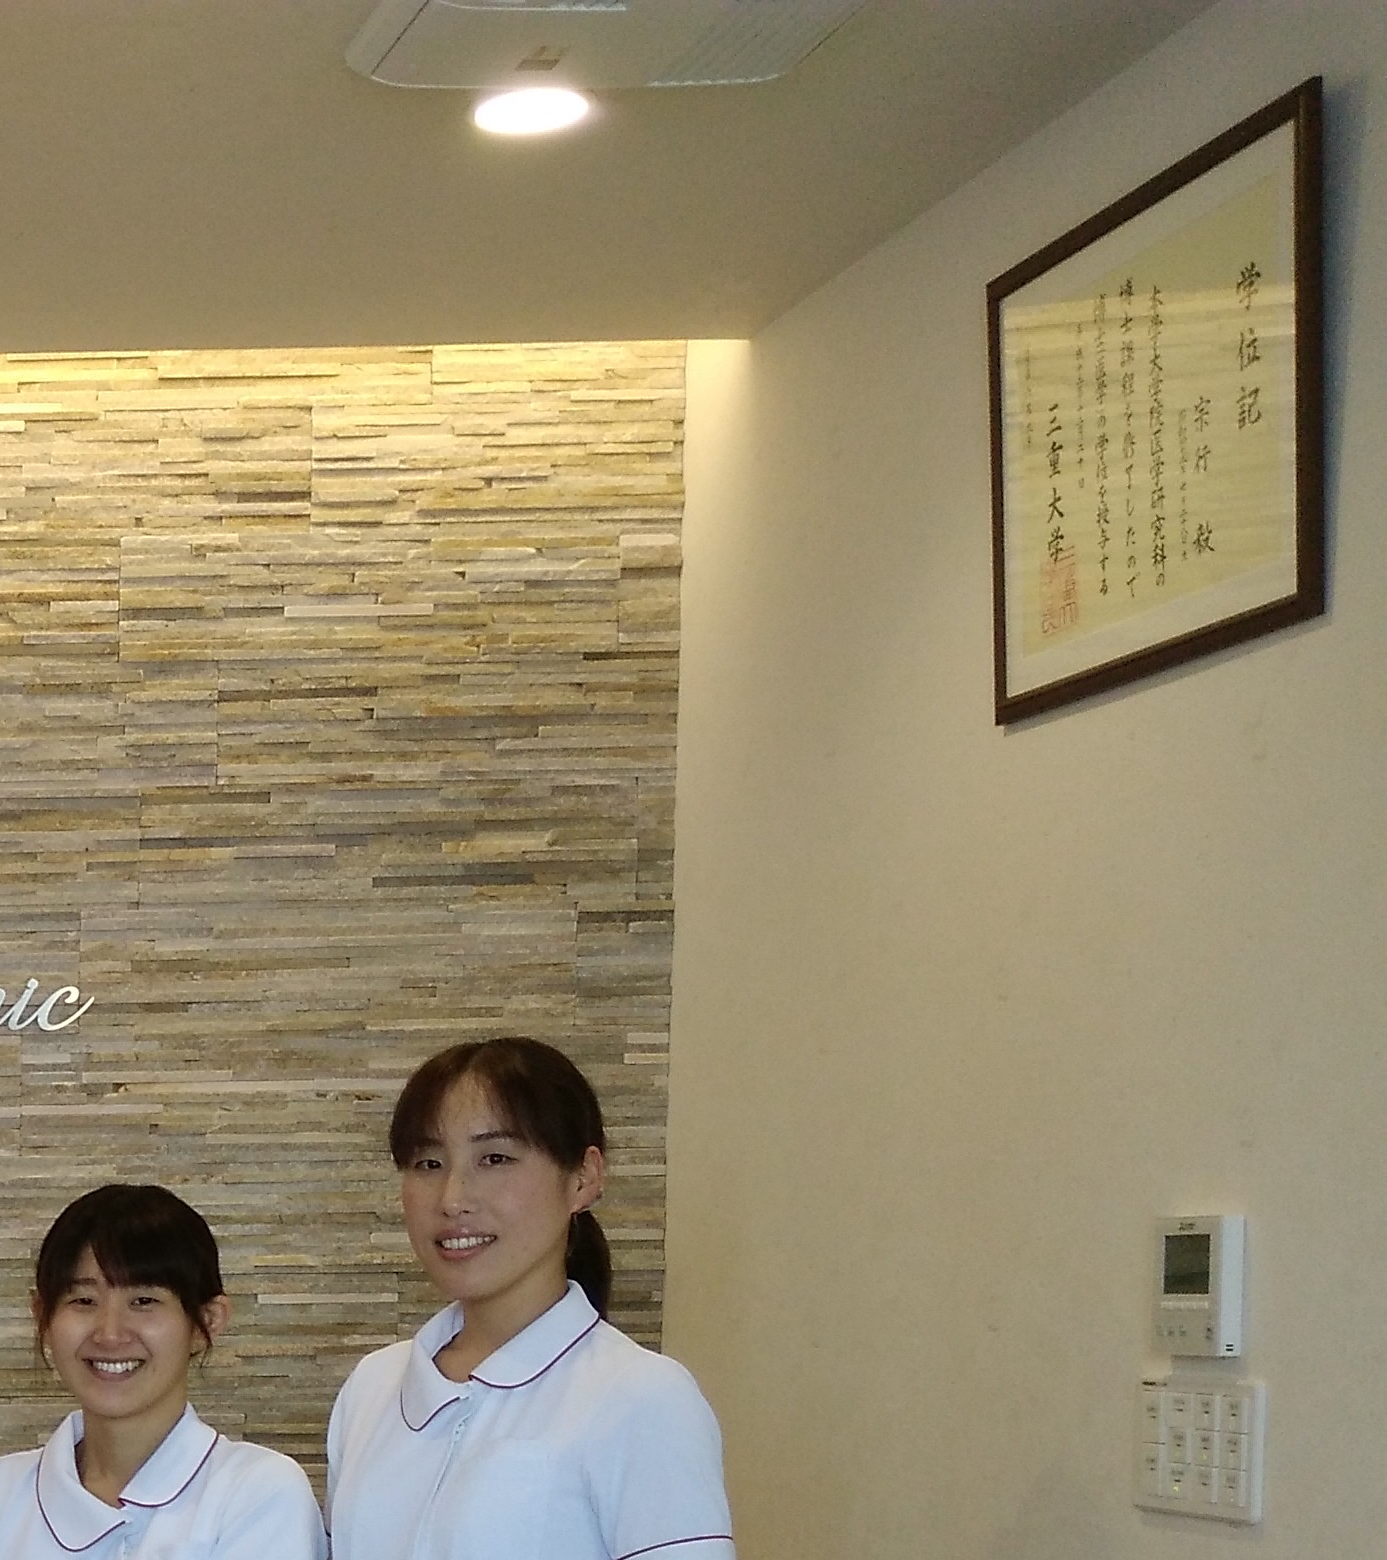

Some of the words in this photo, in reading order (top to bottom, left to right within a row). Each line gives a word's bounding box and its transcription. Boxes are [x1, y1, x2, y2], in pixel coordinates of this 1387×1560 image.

[1235, 261, 1263, 431] 学位記
[1045, 402, 1067, 566] 三重大学
